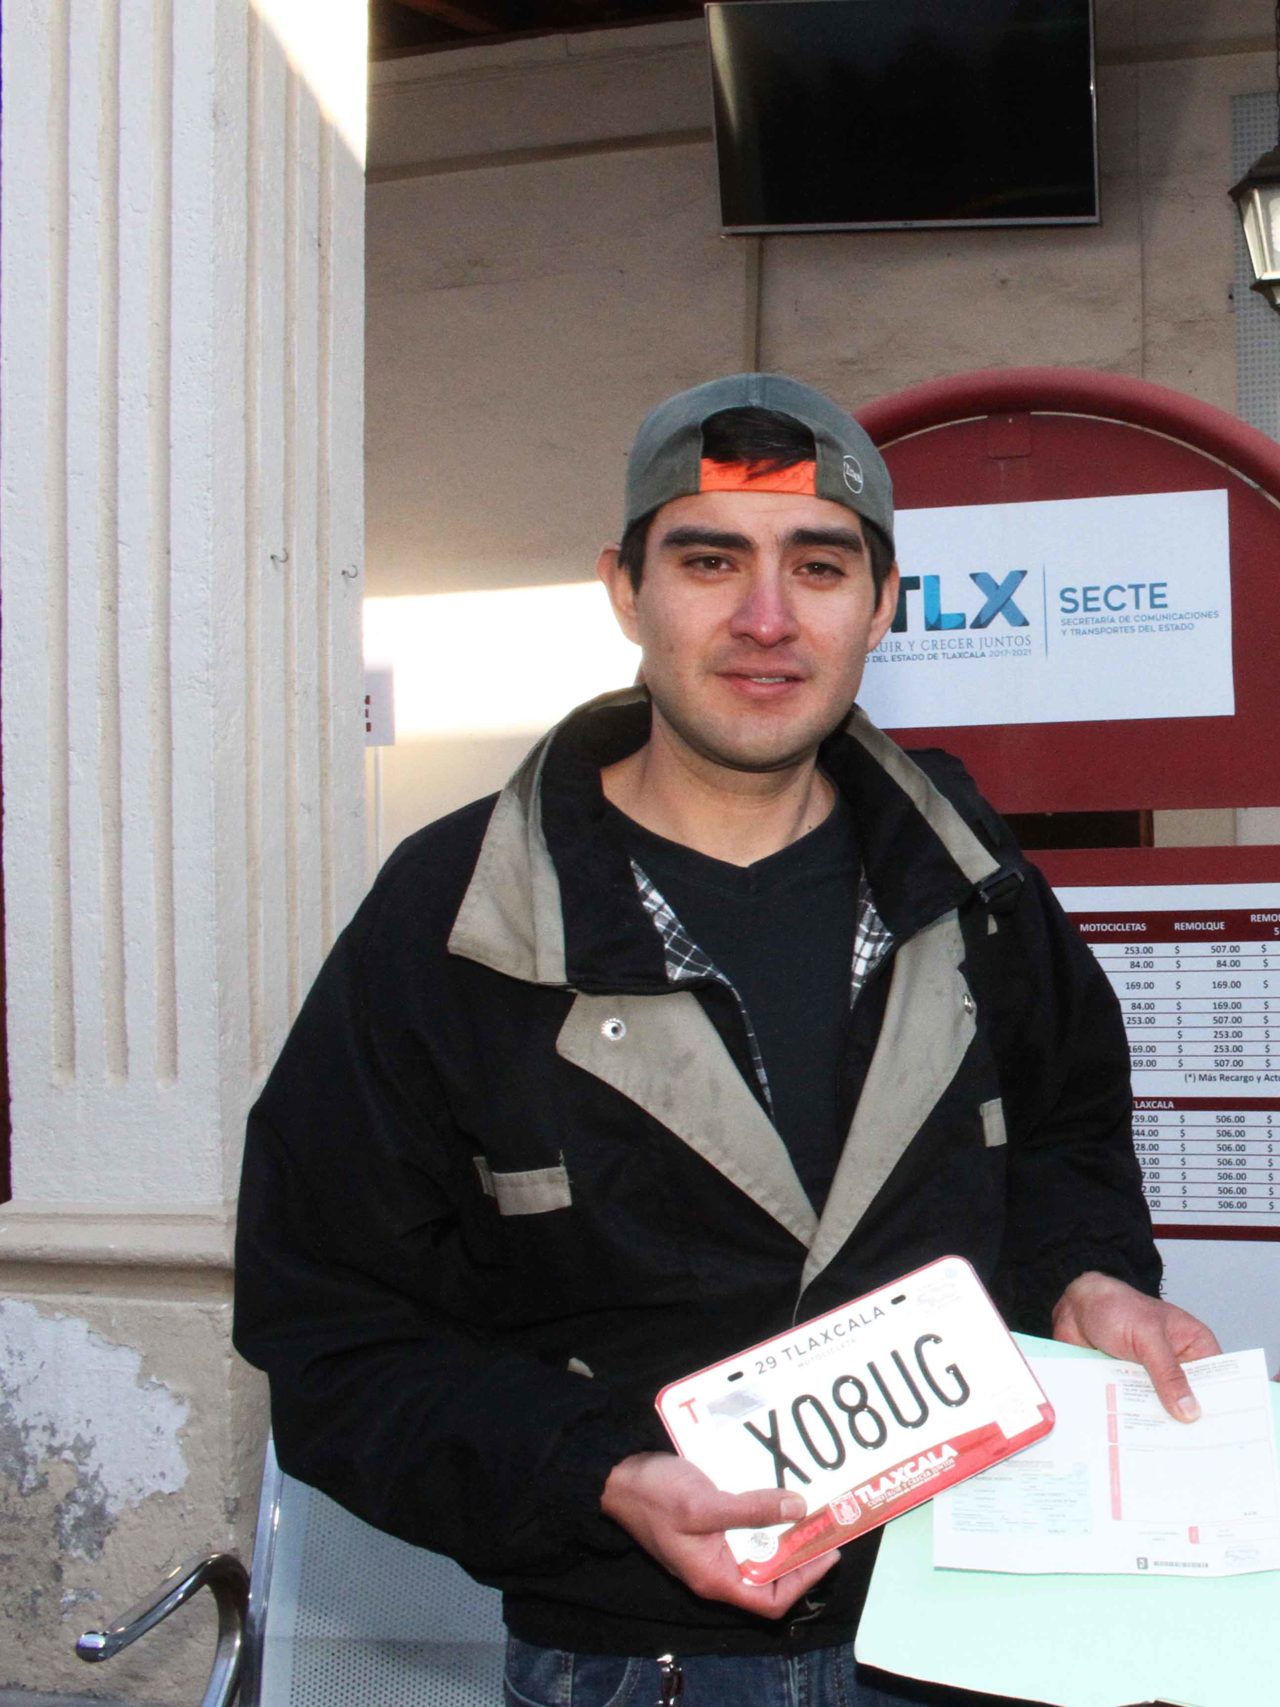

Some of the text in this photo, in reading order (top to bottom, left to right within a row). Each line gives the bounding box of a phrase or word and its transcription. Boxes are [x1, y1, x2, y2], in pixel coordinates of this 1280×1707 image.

[891, 569, 1030, 633] TLX
[1059, 582, 1168, 614] SECTE
[1118, 614, 1131, 623] DE
[1133, 610, 1219, 623] COMUNICACIONES
[1061, 622, 1195, 637] Y TRANSPORTES DEL ESTADO
[908, 639, 916, 650] Y
[920, 637, 974, 650] CRECER
[979, 634, 1031, 649] JUNTOS
[872, 655, 888, 663] DEL
[891, 652, 925, 662] ESTADO
[927, 652, 939, 660] DE
[942, 650, 986, 660] TLAXCALA
[1080, 922, 1147, 932] MOTOCICLETAS
[1174, 921, 1225, 931] REMOLQUE
[1274, 927, 1280, 935] 5
[1124, 946, 1153, 954] 253.00
[1211, 945, 1240, 953] 507.00
[1212, 981, 1241, 989] 169.00
[1213, 1016, 1242, 1024] 507.00
[1214, 1045, 1243, 1053] 253.00
[1214, 1059, 1243, 1067] 507.00
[1198, 1073, 1217, 1081] Más
[1219, 1074, 1254, 1083] Recargo
[1256, 1075, 1262, 1083] y
[1132, 1115, 1158, 1123] 59.00
[1216, 1115, 1245, 1123] 506.00
[1132, 1129, 1159, 1137] 44.00
[1216, 1130, 1245, 1138] 506.00
[1135, 1143, 1159, 1151] 28.00
[1217, 1144, 1246, 1152] 506.00
[1217, 1158, 1246, 1166] 506.00
[1218, 1187, 1247, 1195] 506.00
[1218, 1201, 1247, 1209] 506.00
[755, 1306, 886, 1375] 29 TLAXCALA
[678, 1397, 700, 1425] T
[742, 1333, 971, 1489] X08UG
[854, 1443, 959, 1504] TLAXCALA
